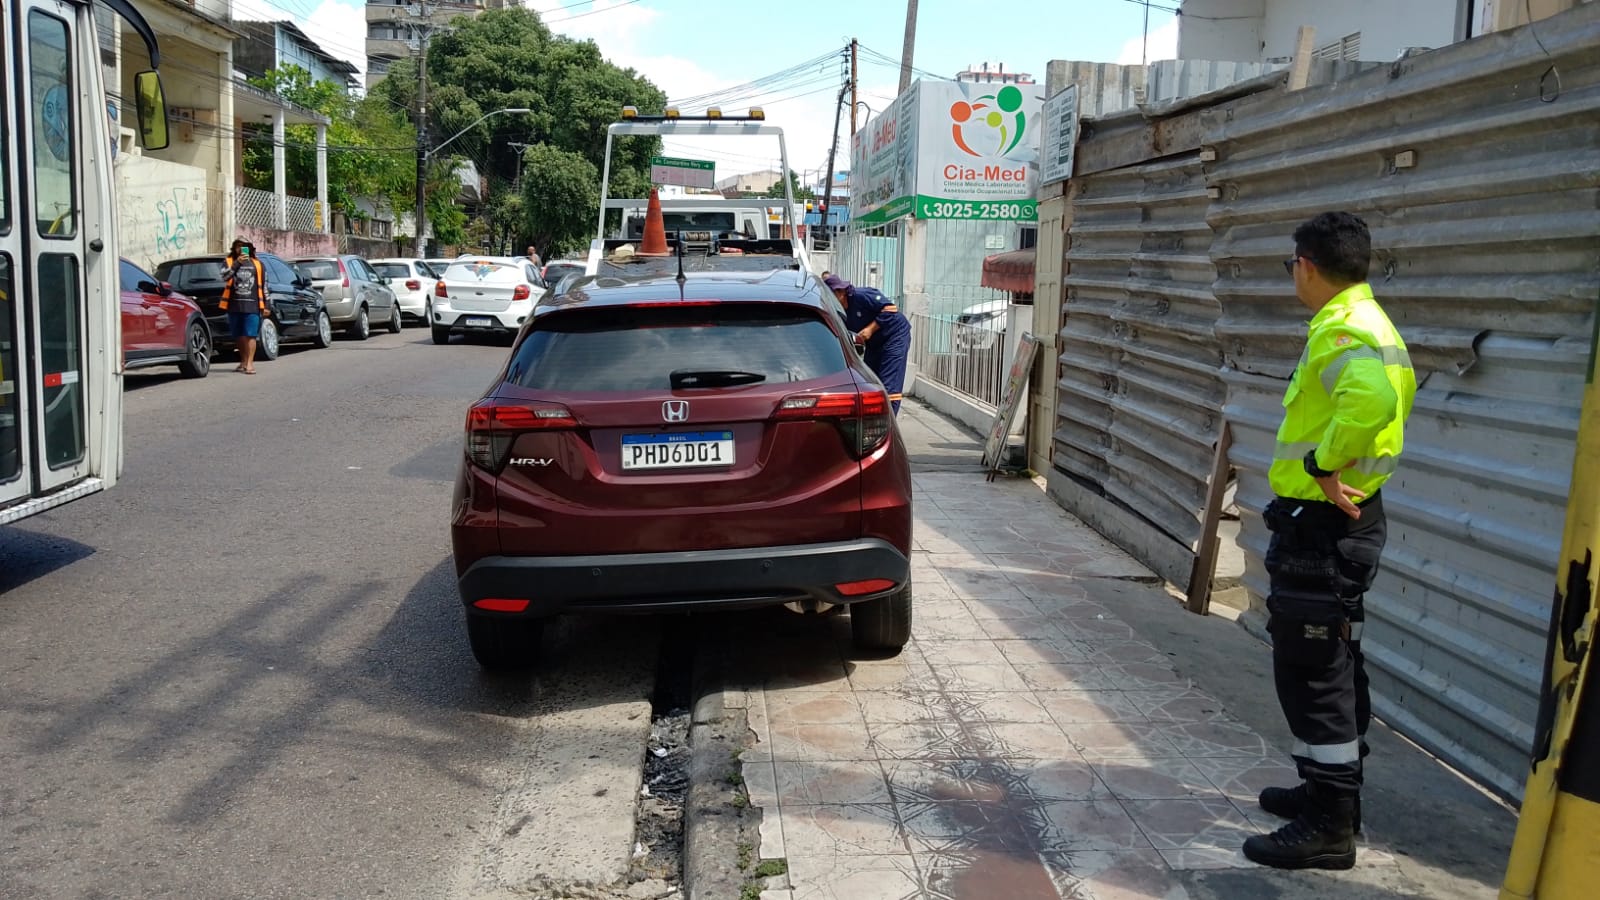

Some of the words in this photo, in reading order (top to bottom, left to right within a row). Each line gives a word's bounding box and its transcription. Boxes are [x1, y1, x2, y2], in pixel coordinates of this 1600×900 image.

[943, 164, 1026, 182] Cia-Med
[933, 203, 1020, 219] 3025-2580
[509, 458, 554, 467] HR-V
